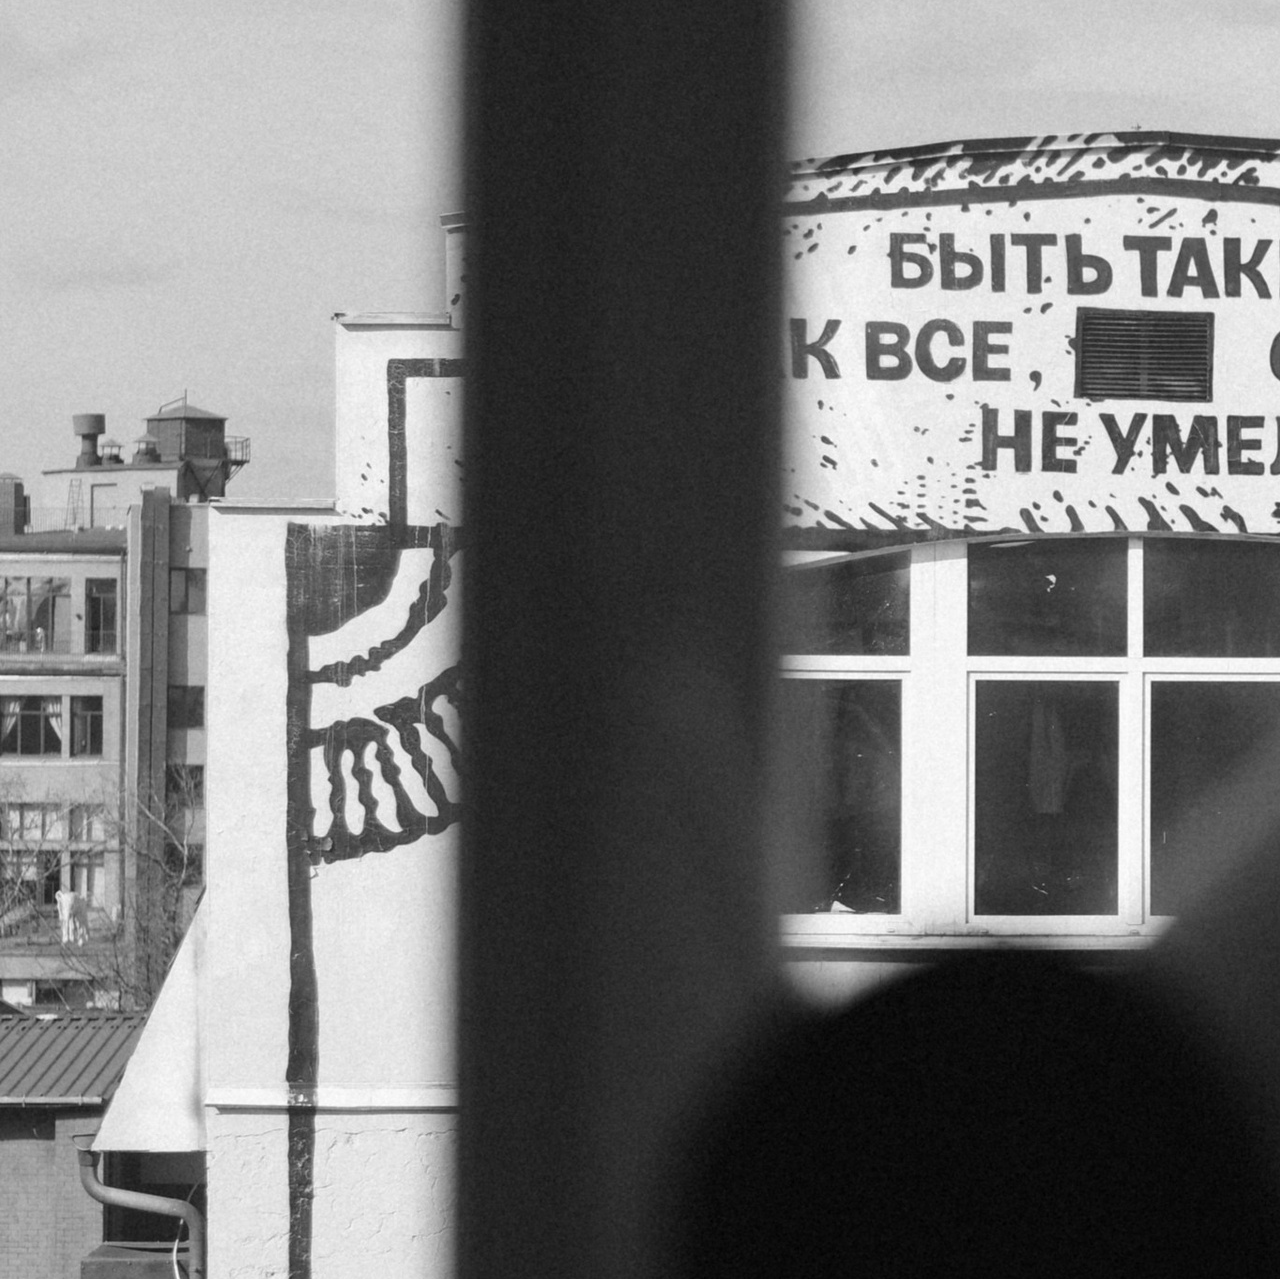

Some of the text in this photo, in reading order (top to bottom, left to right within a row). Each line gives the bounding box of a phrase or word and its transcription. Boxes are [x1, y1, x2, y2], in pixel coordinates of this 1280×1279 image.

[889, 232, 1113, 295] БЫТЬ
[787, 317, 842, 380] К
[865, 319, 1042, 390] ВСЕ,
[981, 407, 1079, 473] НЕ
